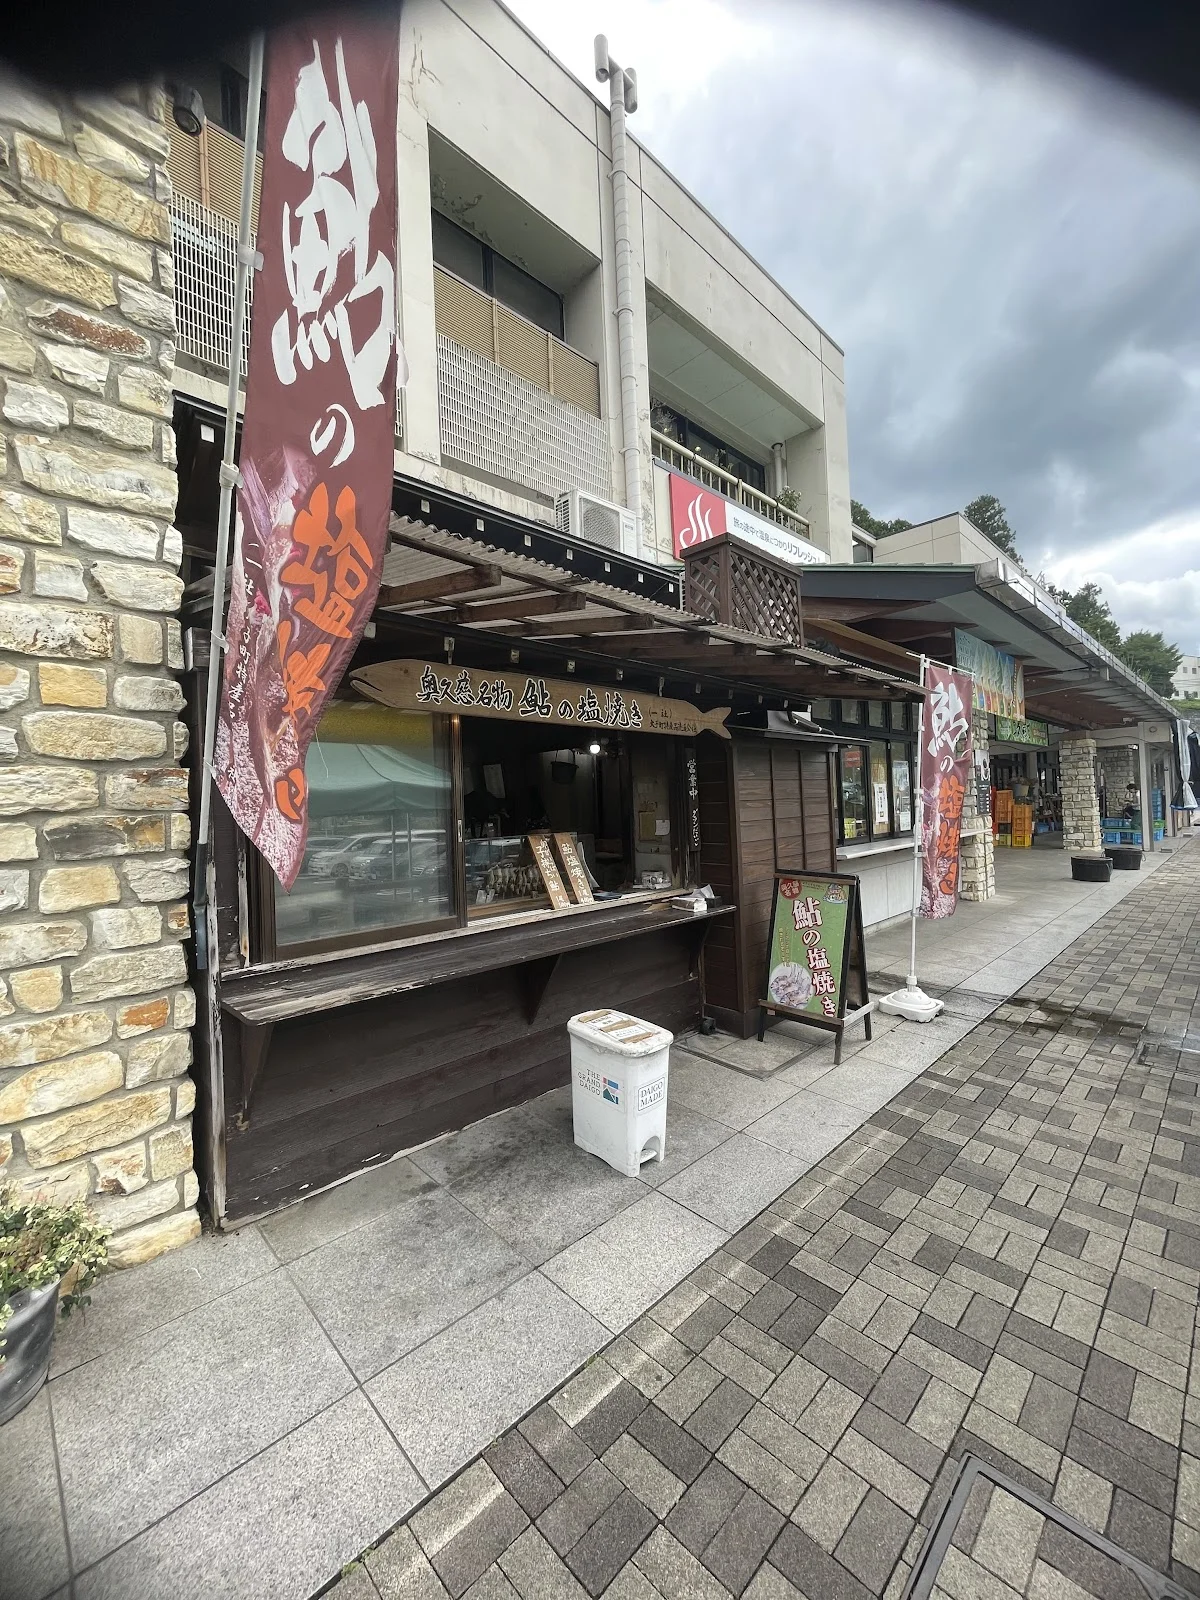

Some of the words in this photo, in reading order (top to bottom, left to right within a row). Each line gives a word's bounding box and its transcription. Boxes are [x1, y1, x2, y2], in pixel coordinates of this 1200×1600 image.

[416, 665, 513, 711] 奥久慈名物
[519, 677, 643, 728] 鮎の塩焼き
[686, 758, 699, 801] 営業中
[792, 896, 836, 1018] 鮎の塩焼き
[577, 1071, 601, 1088] GRAND
[586, 1068, 601, 1081] THE
[579, 1080, 601, 1096] DAIGO
[640, 1081, 663, 1098] DAIGO
[640, 1089, 663, 1107] MADE
